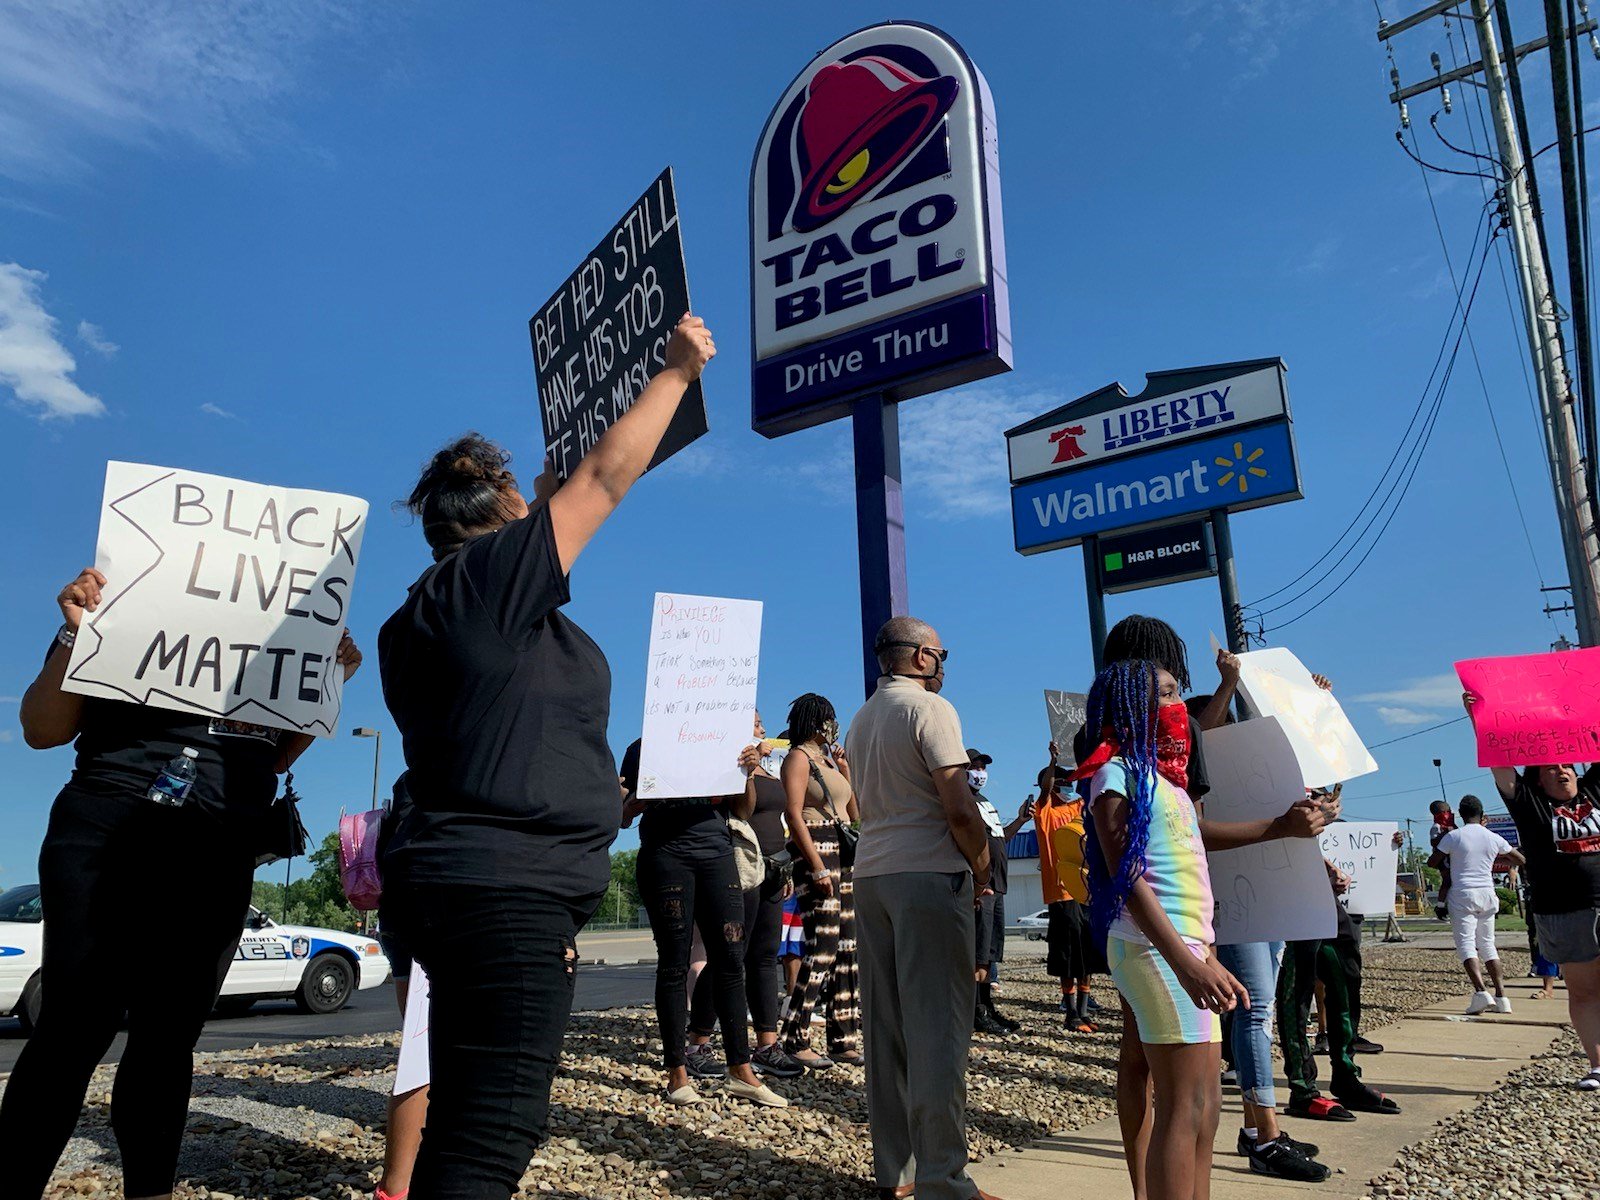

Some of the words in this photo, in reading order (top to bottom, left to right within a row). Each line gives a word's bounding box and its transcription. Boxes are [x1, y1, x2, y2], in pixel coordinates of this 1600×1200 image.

[761, 194, 957, 288] TACO
[533, 291, 566, 374] BET
[613, 180, 678, 282] STILL
[775, 242, 965, 332] BELL
[541, 352, 586, 436] HAVE
[583, 318, 614, 390] HIS
[615, 265, 665, 355] JOB
[785, 352, 863, 394] Drive
[873, 322, 949, 364] Thru
[546, 428, 573, 480] IF
[577, 397, 609, 459] HIS
[612, 348, 651, 424] MASK
[1102, 386, 1232, 442] LIBERTY
[1114, 415, 1223, 449] PLAZA
[172, 483, 361, 566] BLACK
[1032, 459, 1210, 528] Walmart
[185, 541, 348, 627] LIVES
[1127, 550, 1155, 564] H&R
[1157, 540, 1201, 557] BLOCK
[695, 626, 721, 652] YOU
[1501, 743, 1548, 762] TACO
[1568, 724, 1600, 737] Liber
[1349, 831, 1383, 850] NOT
[1364, 856, 1376, 869] it
